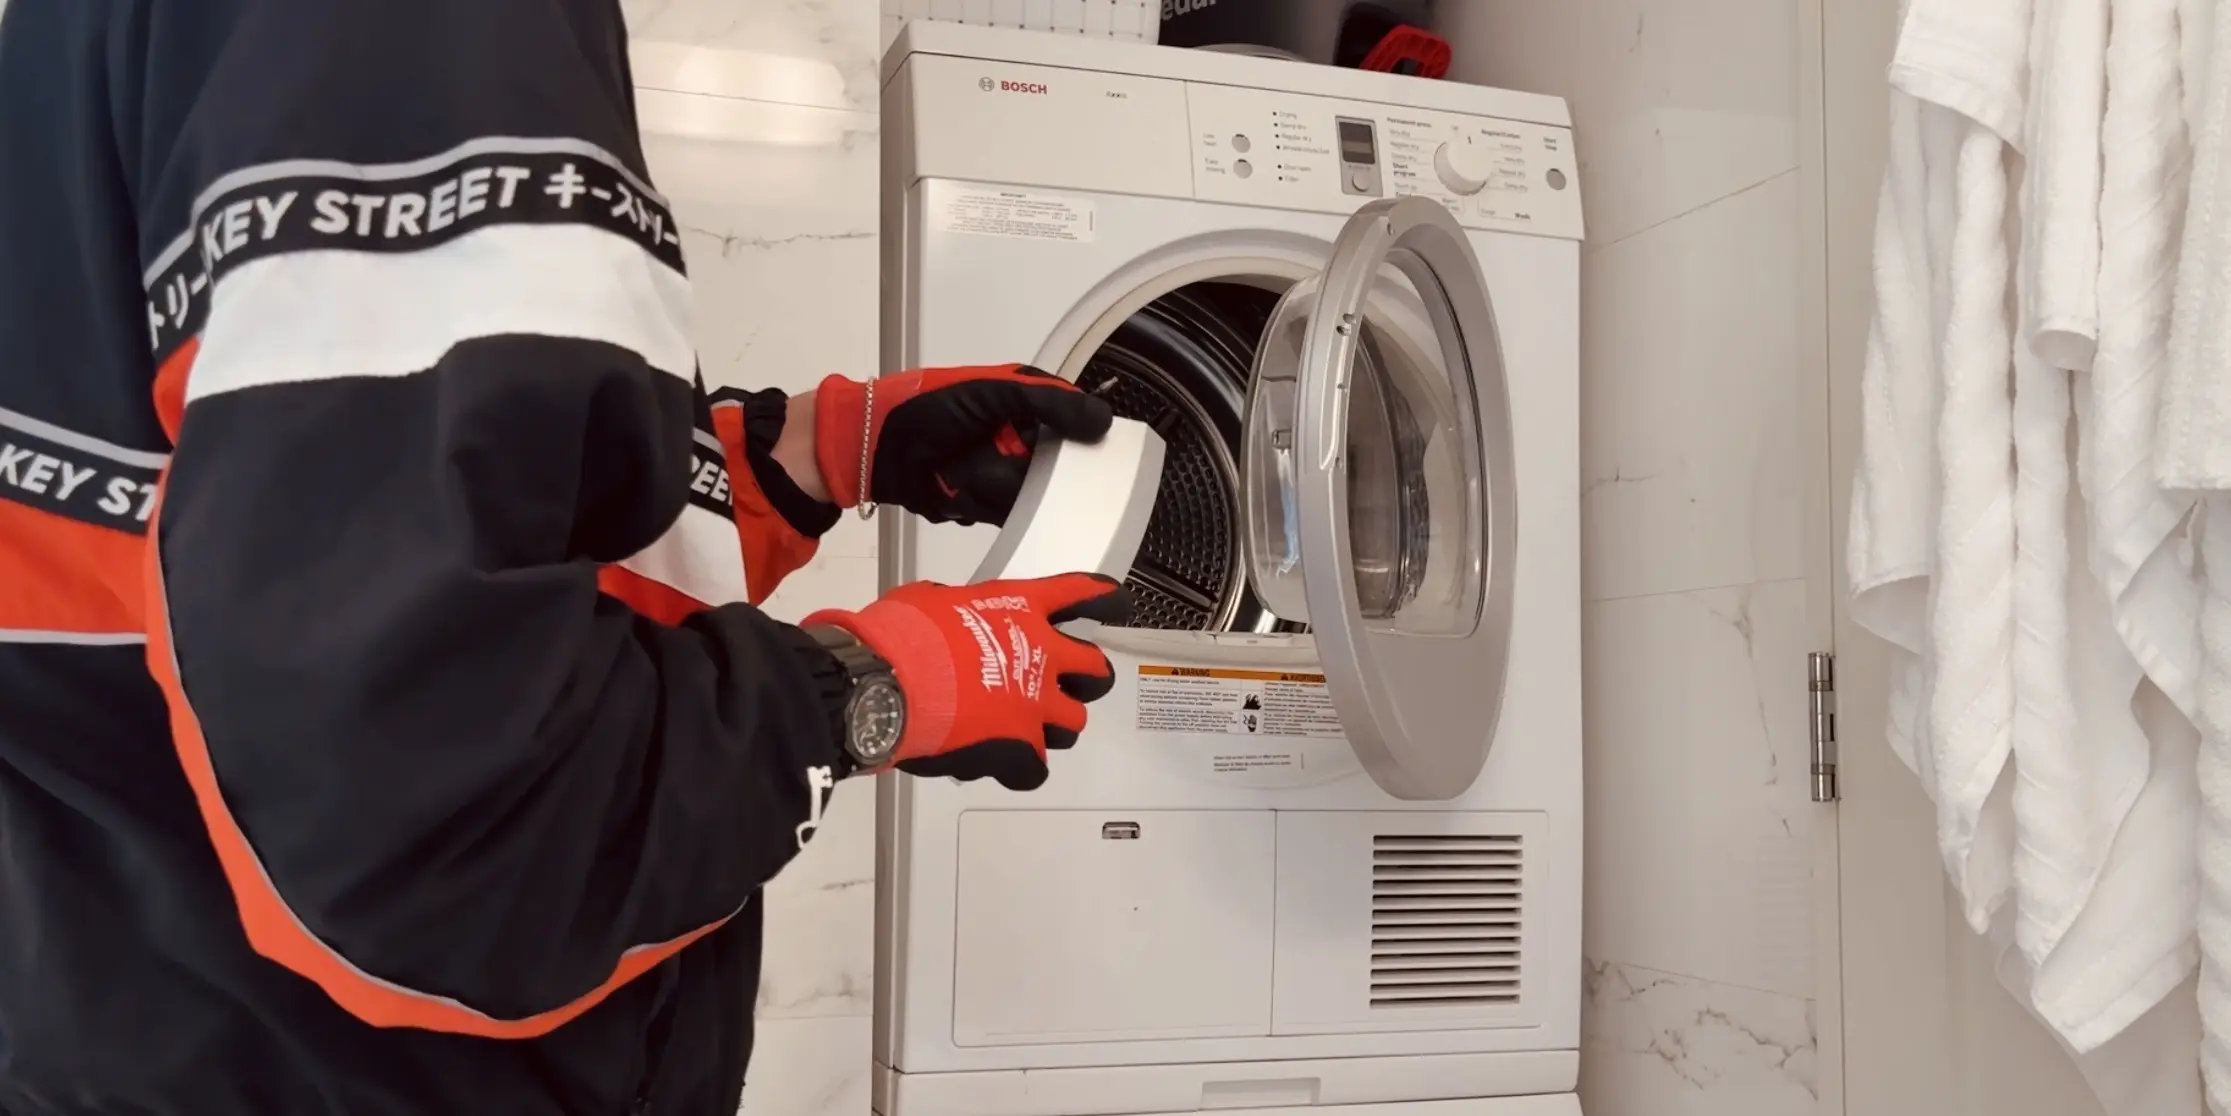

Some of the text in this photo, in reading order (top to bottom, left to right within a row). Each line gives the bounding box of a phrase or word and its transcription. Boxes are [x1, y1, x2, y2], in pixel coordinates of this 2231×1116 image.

[1001, 80, 1048, 94] BOSCH
[203, 165, 531, 261] KEY STREET
[0, 443, 98, 501] KEY
